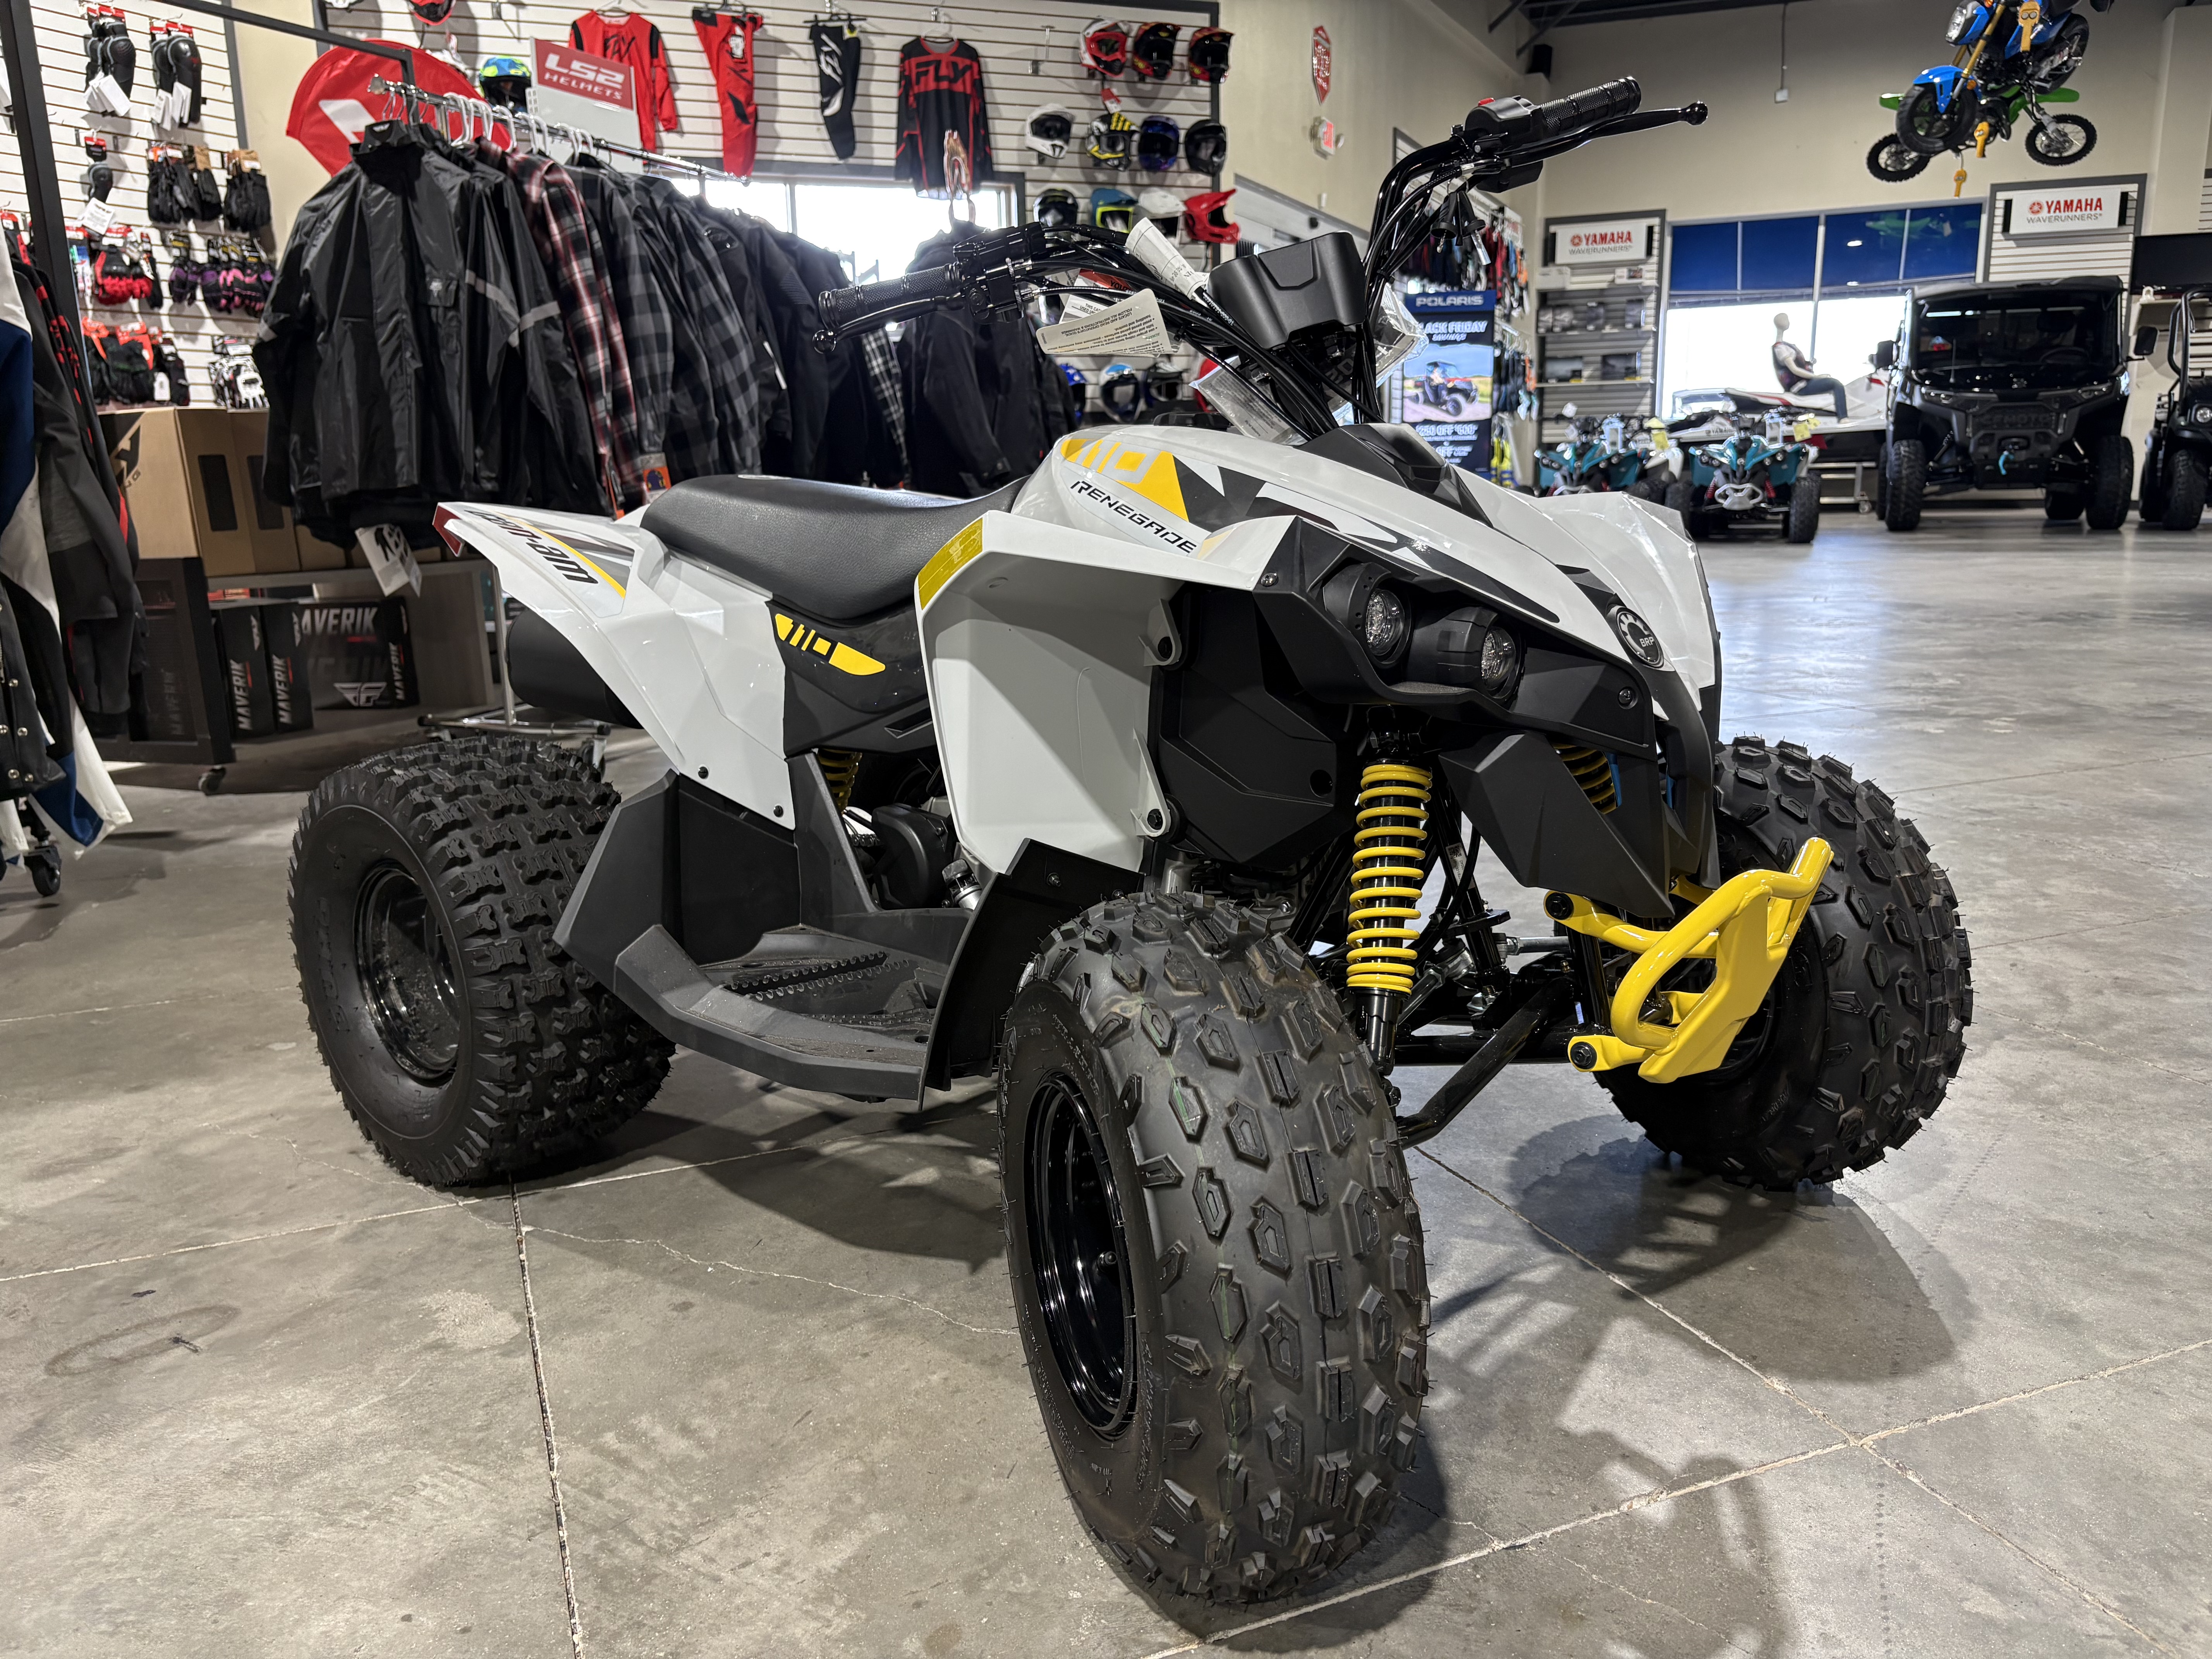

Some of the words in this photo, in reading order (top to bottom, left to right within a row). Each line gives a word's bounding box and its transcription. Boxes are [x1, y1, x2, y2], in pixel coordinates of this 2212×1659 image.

[545, 53, 625, 89] LS2
[915, 61, 972, 84] FLY
[544, 72, 622, 100] HELMETS
[2046, 197, 2102, 214] YAMAHA
[1584, 230, 1633, 246] YAMAHA
[1416, 295, 1484, 306] POLARIS
[1077, 325, 1099, 333] OPERATOR'S
[1084, 317, 1110, 328] INSTRUCTIONS
[1448, 321, 1488, 333] FRIDAY
[1436, 424, 1454, 436] OFF
[1075, 440, 1162, 484] 110
[1070, 480, 1197, 554] RENEGADE
[464, 510, 599, 584] can-am
[301, 607, 378, 636] AVERIK
[784, 620, 839, 663] 110
[1639, 637, 1654, 647] BRP
[388, 642, 405, 701] MAVERIK
[230, 659, 252, 730] MAVERIK
[272, 654, 293, 725] MAVERIK
